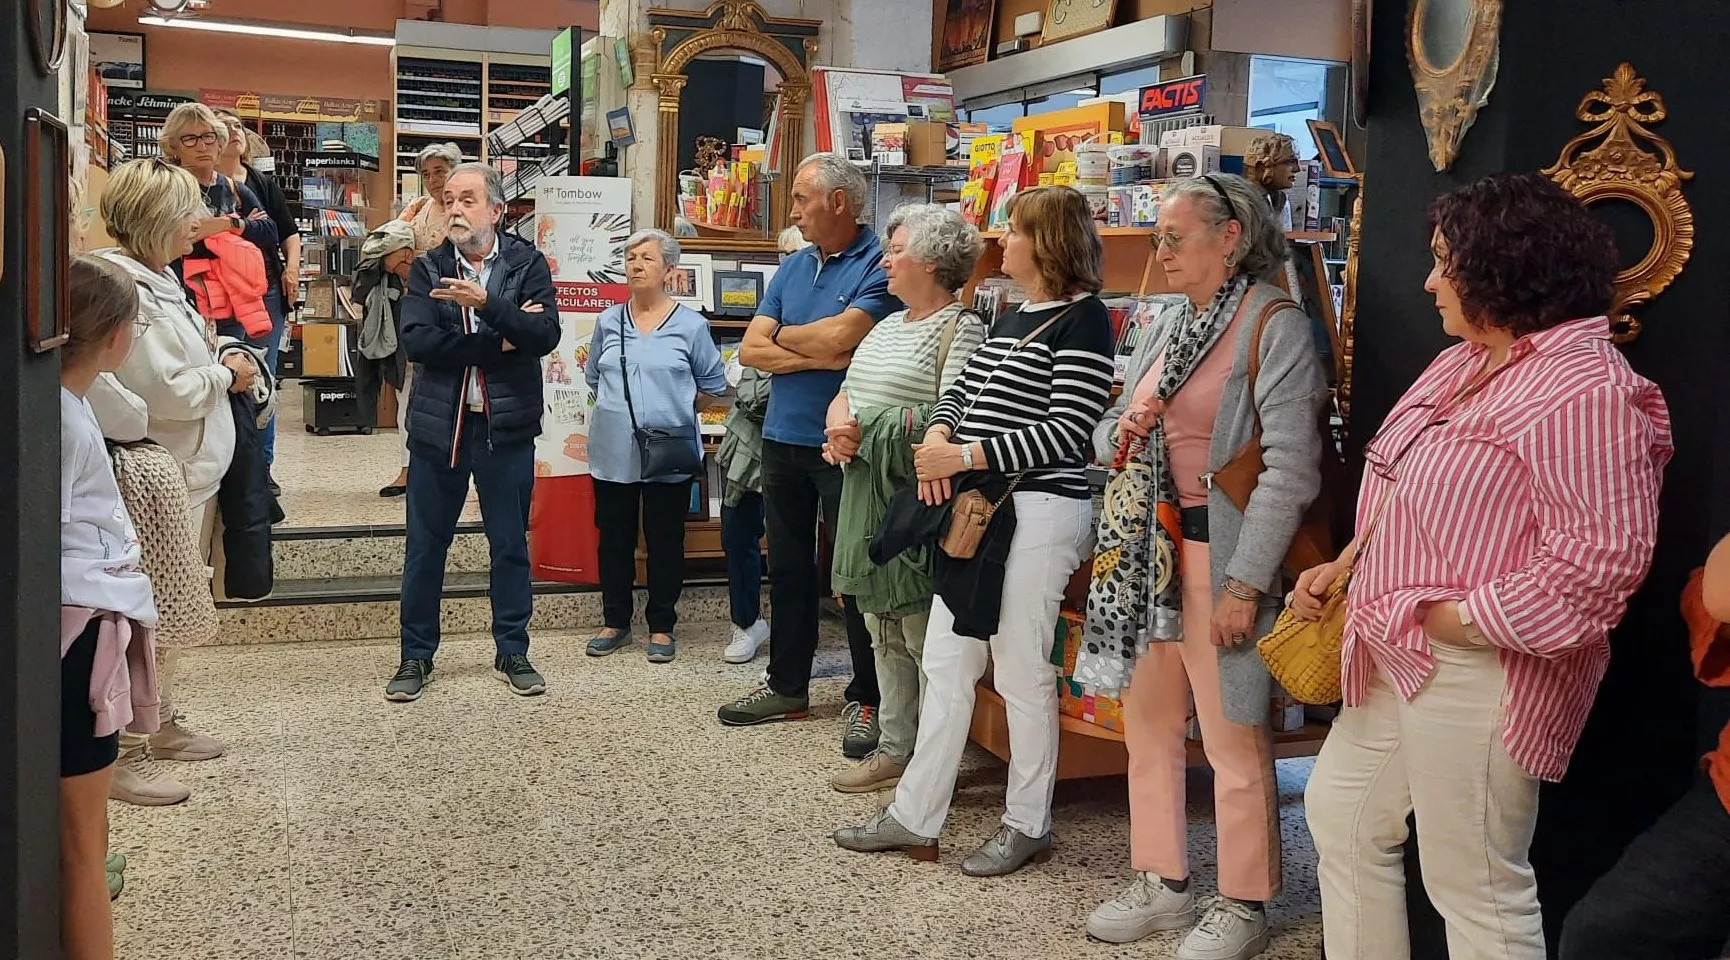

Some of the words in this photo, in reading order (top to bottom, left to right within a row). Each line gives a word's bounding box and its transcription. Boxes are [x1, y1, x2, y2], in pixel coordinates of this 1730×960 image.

[107, 96, 133, 106] ncke
[1141, 80, 1204, 112] FACTIS
[974, 143, 996, 152] GIOTTO
[305, 157, 355, 167] paperblanks
[556, 188, 602, 199] Tombow
[555, 298, 615, 308] ACULARES!
